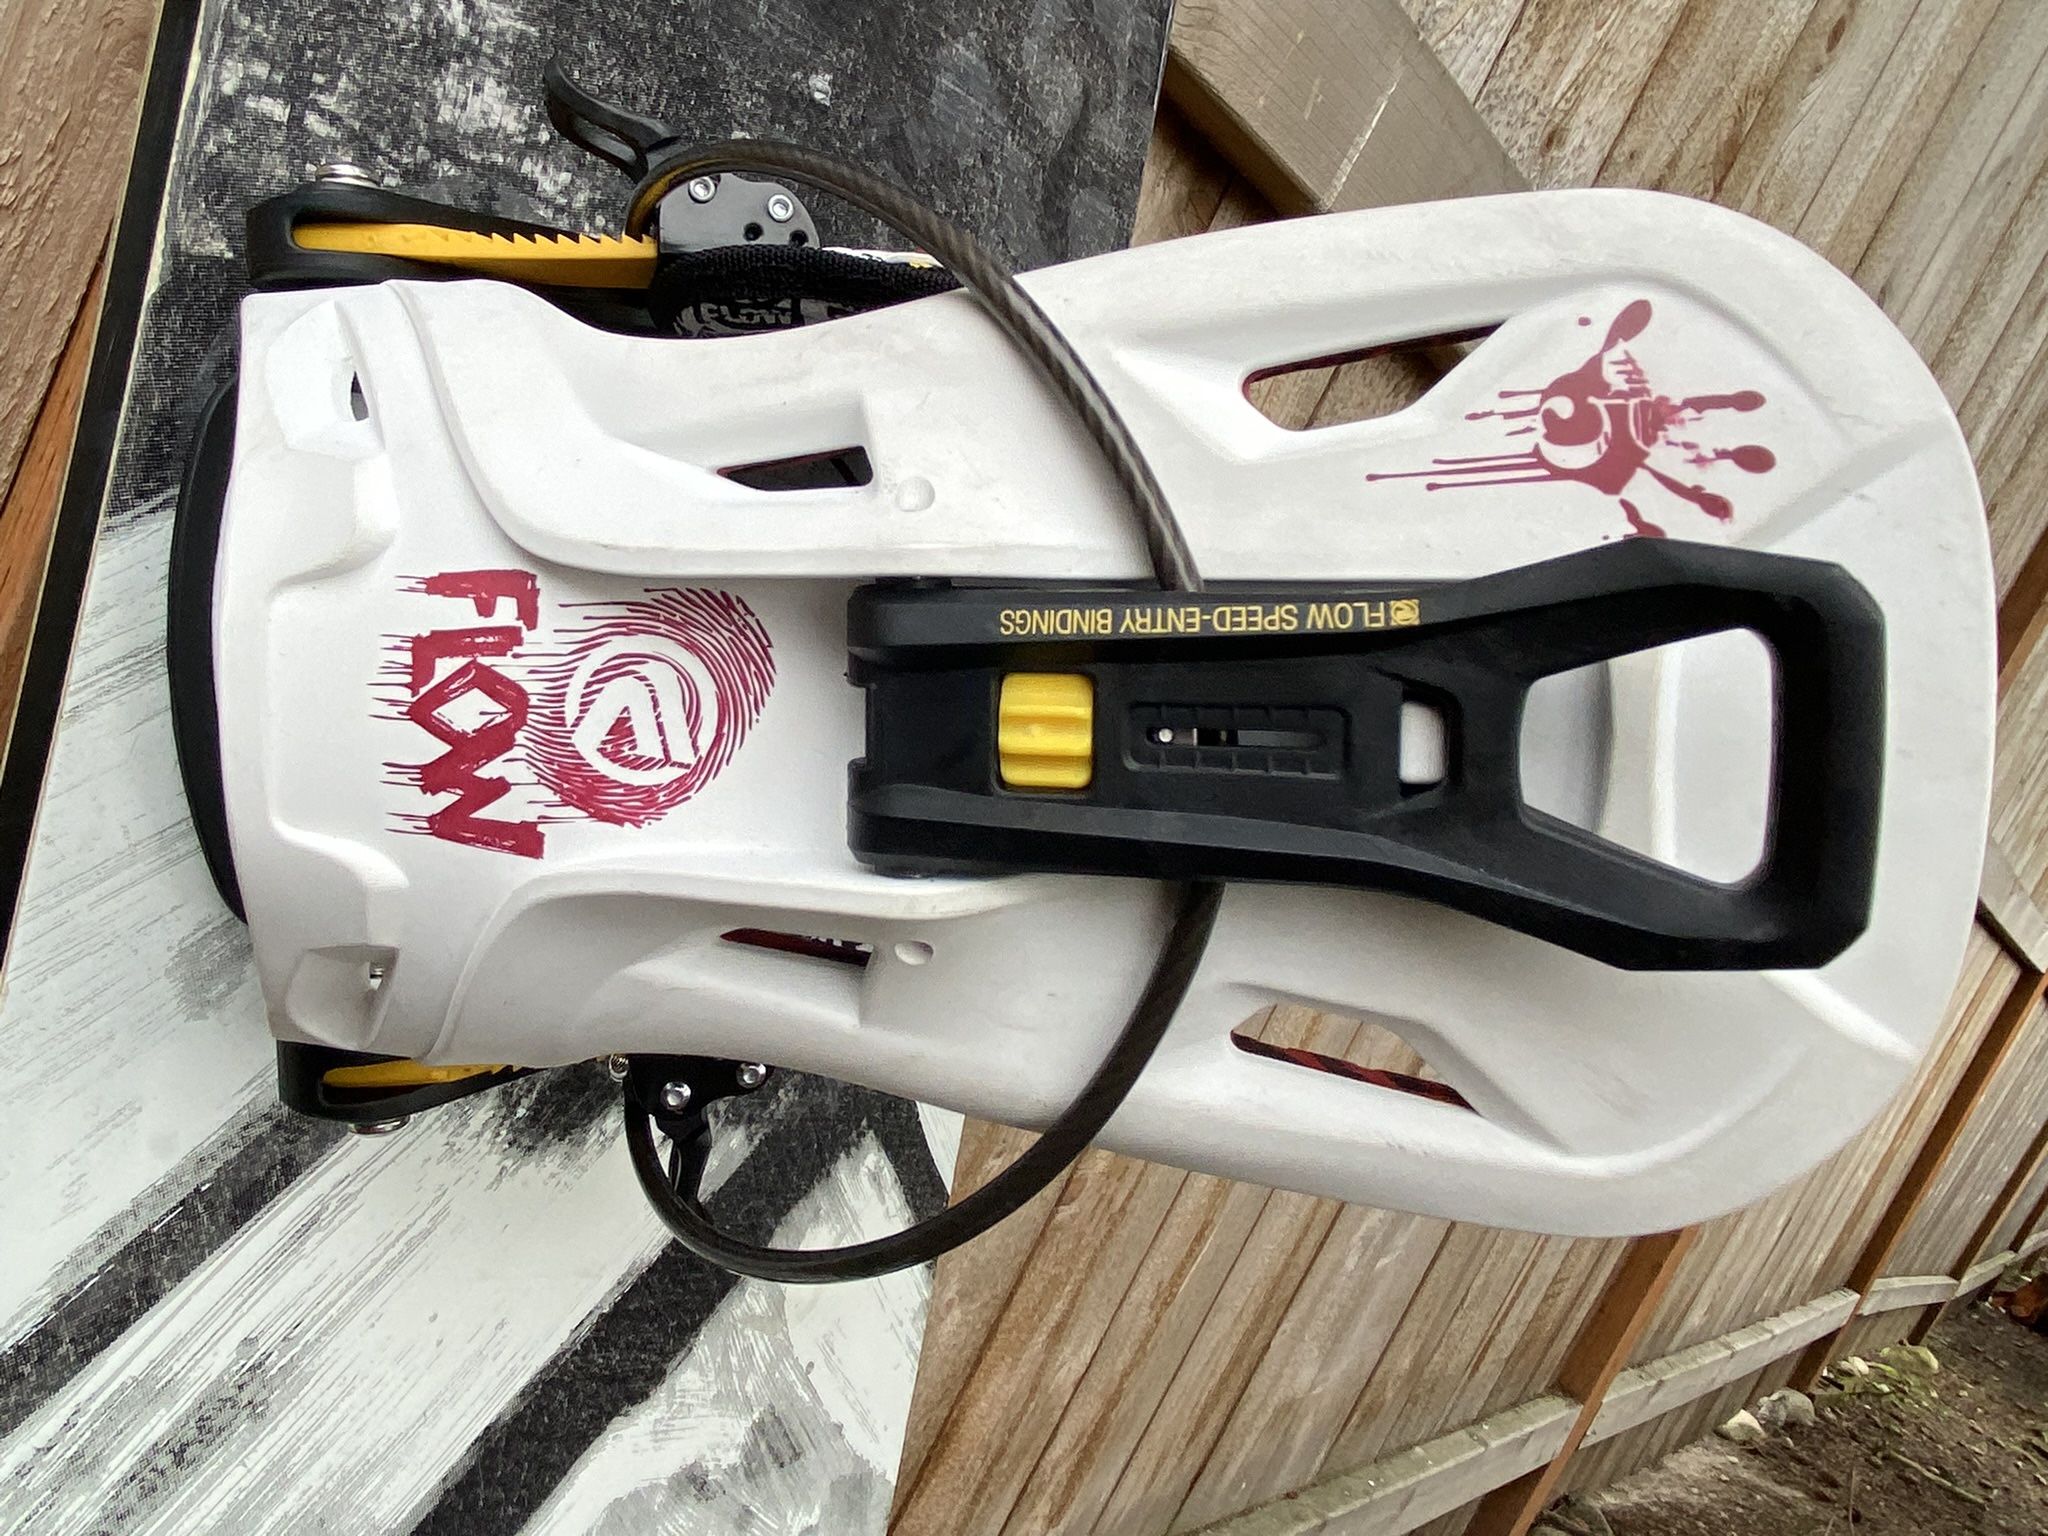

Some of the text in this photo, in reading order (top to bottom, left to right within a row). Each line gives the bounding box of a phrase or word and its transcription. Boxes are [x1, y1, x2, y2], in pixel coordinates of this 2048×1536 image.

[1000, 601, 1385, 635] FLOW SPEED-ENTRY BINDINGS
[400, 569, 546, 860] FLOW
